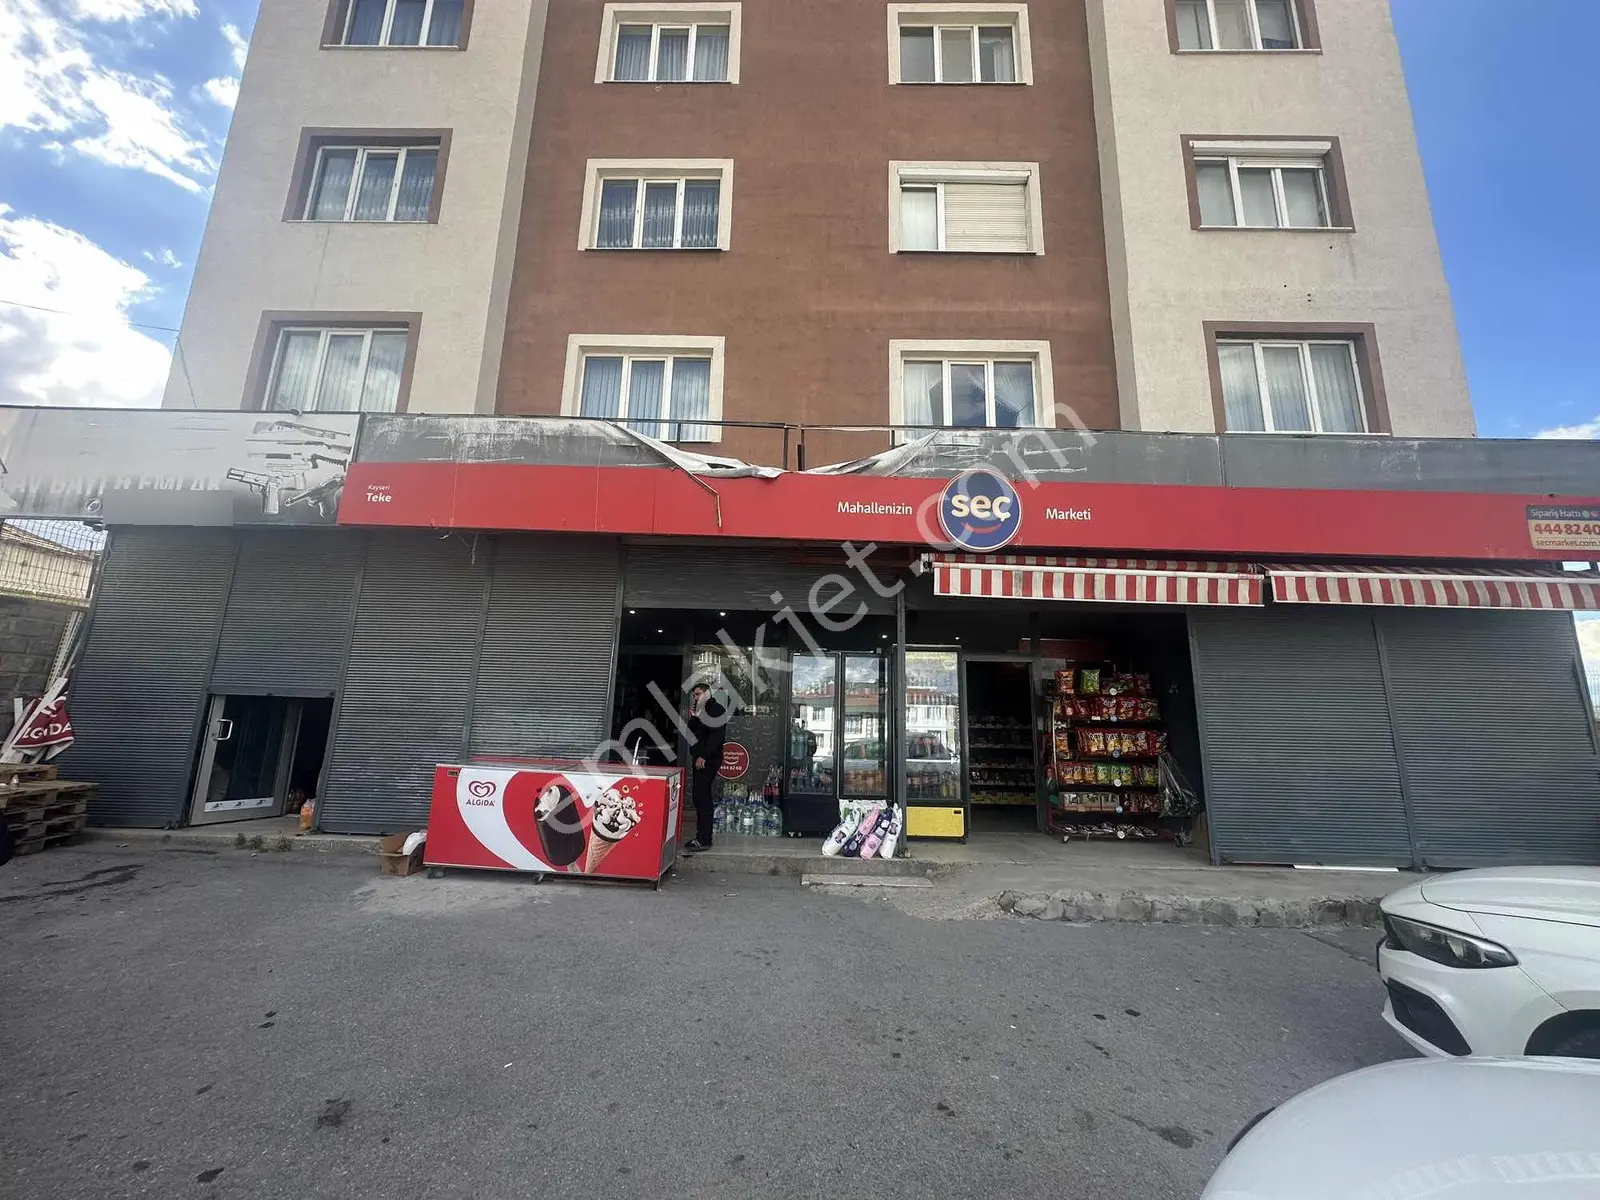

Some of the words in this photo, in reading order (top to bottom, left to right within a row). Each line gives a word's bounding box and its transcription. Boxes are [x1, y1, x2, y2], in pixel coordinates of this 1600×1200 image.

[366, 492, 392, 502] Teke
[837, 501, 912, 516] Mahallenizin
[951, 493, 1011, 522] seç
[1045, 507, 1091, 521] Marketi
